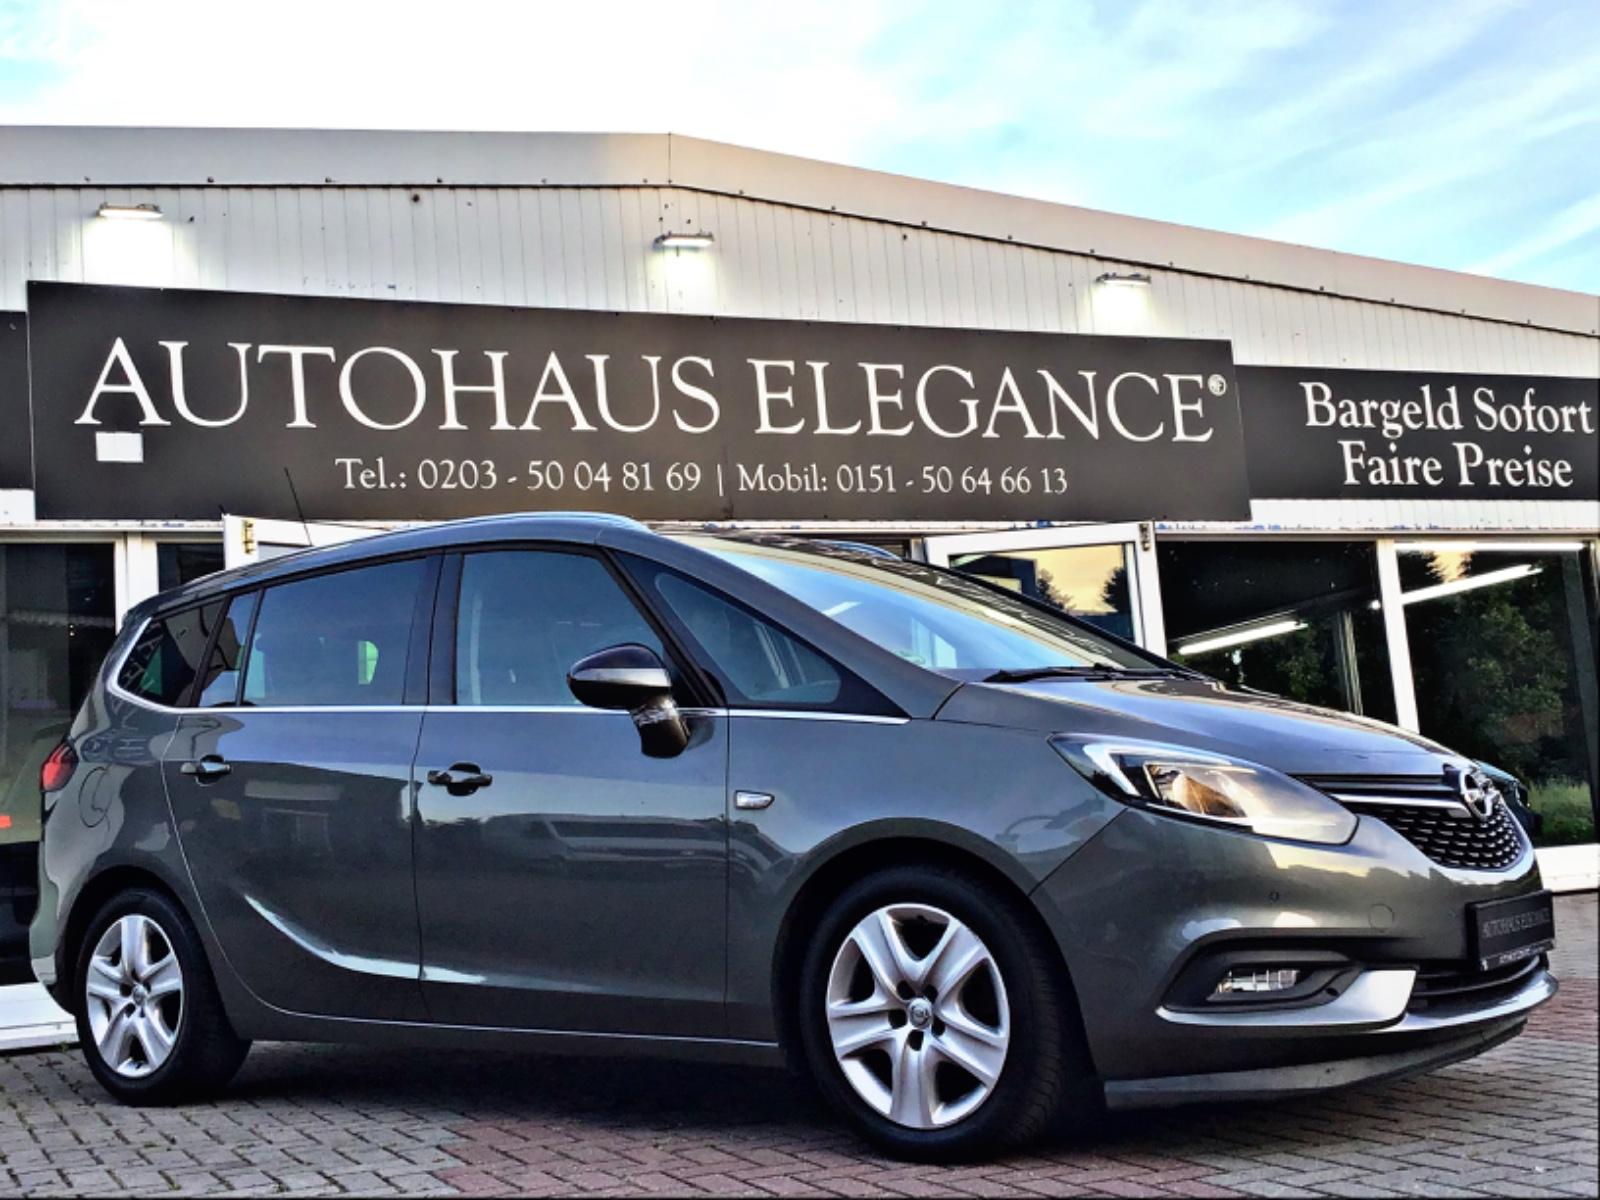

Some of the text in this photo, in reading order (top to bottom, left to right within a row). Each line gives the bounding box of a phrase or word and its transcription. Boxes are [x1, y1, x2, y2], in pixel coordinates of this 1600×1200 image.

[75, 337, 720, 433] AUTOHAUS
[1299, 381, 1595, 439] Bargeld Sofort
[334, 457, 407, 489] Tel.:
[417, 458, 498, 490] 0203
[526, 459, 565, 491] 50
[573, 460, 613, 493] 04
[622, 461, 655, 491] 81
[665, 461, 702, 492] 69
[735, 462, 828, 493] Mobil:
[836, 463, 897, 493] 0151
[922, 465, 954, 493] 50
[960, 465, 993, 495] 64
[1000, 466, 1032, 494] 66
[1040, 467, 1068, 495] 13
[1338, 440, 1573, 487] Faire Preise
